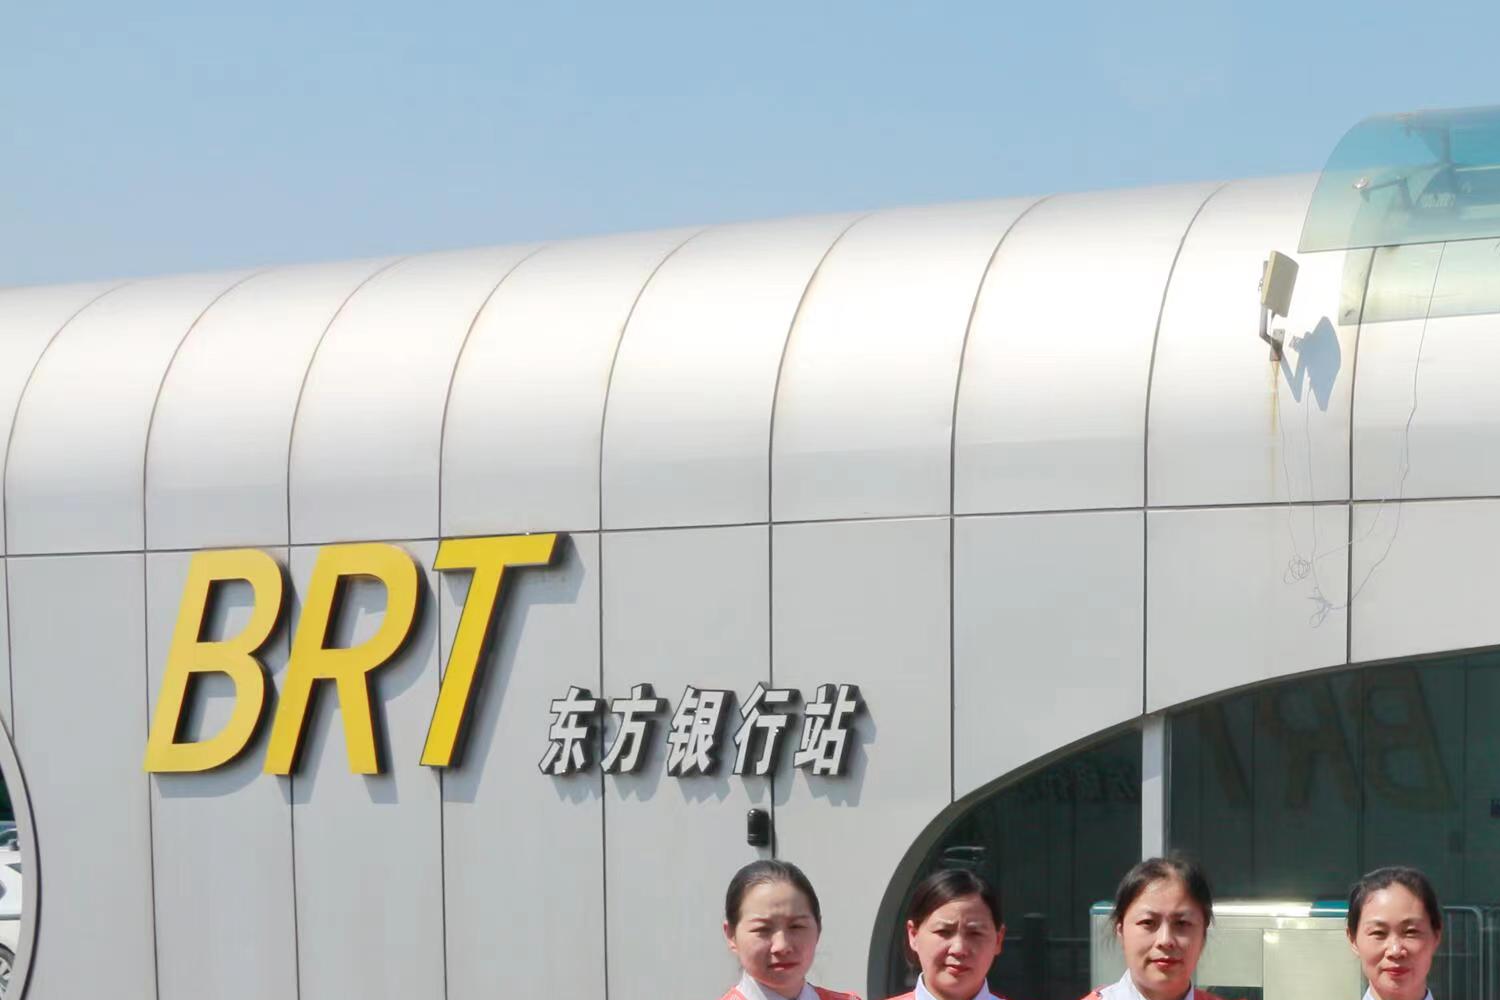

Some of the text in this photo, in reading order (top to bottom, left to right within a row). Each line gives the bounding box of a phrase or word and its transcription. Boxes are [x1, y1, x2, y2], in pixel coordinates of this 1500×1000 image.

[145, 533, 565, 775] BRT
[538, 684, 860, 776] 东方银行站
